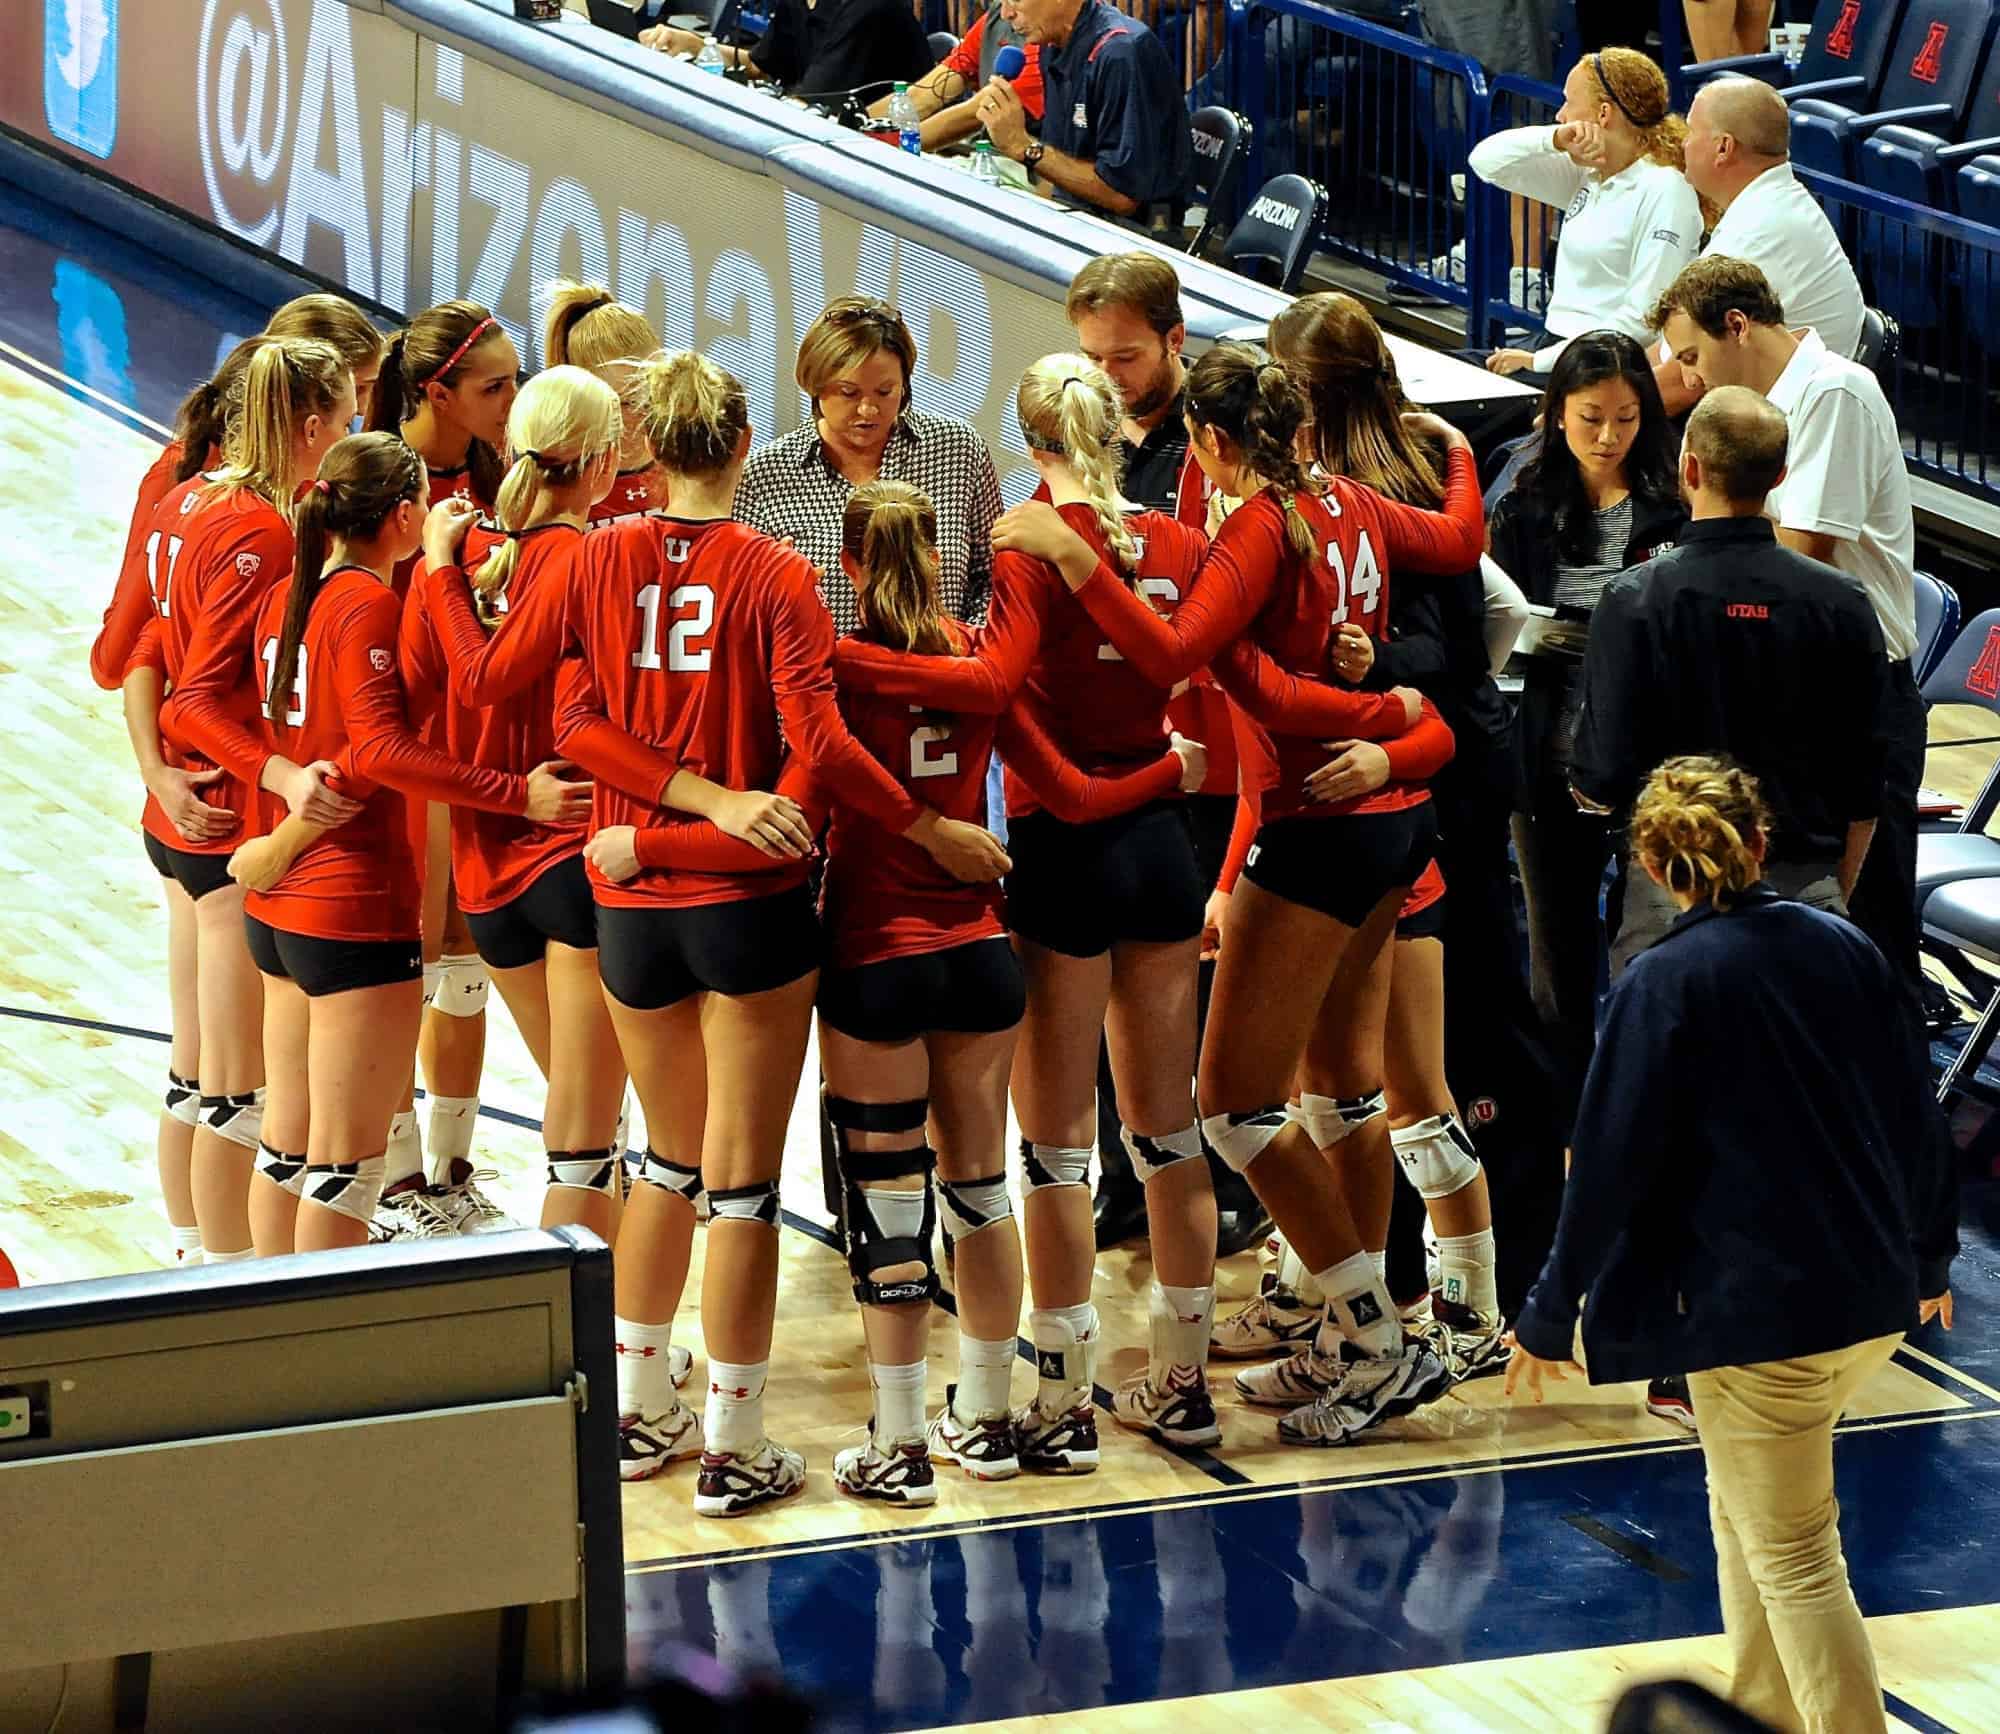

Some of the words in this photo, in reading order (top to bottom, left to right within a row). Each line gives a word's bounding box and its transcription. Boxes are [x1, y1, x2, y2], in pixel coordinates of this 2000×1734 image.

[1910, 20, 1949, 85] A
[1248, 196, 1300, 231] ARIZONA
[665, 537, 691, 563] U
[1327, 529, 1381, 625] 14
[631, 584, 715, 672] 12
[1726, 603, 1769, 619] UTAH
